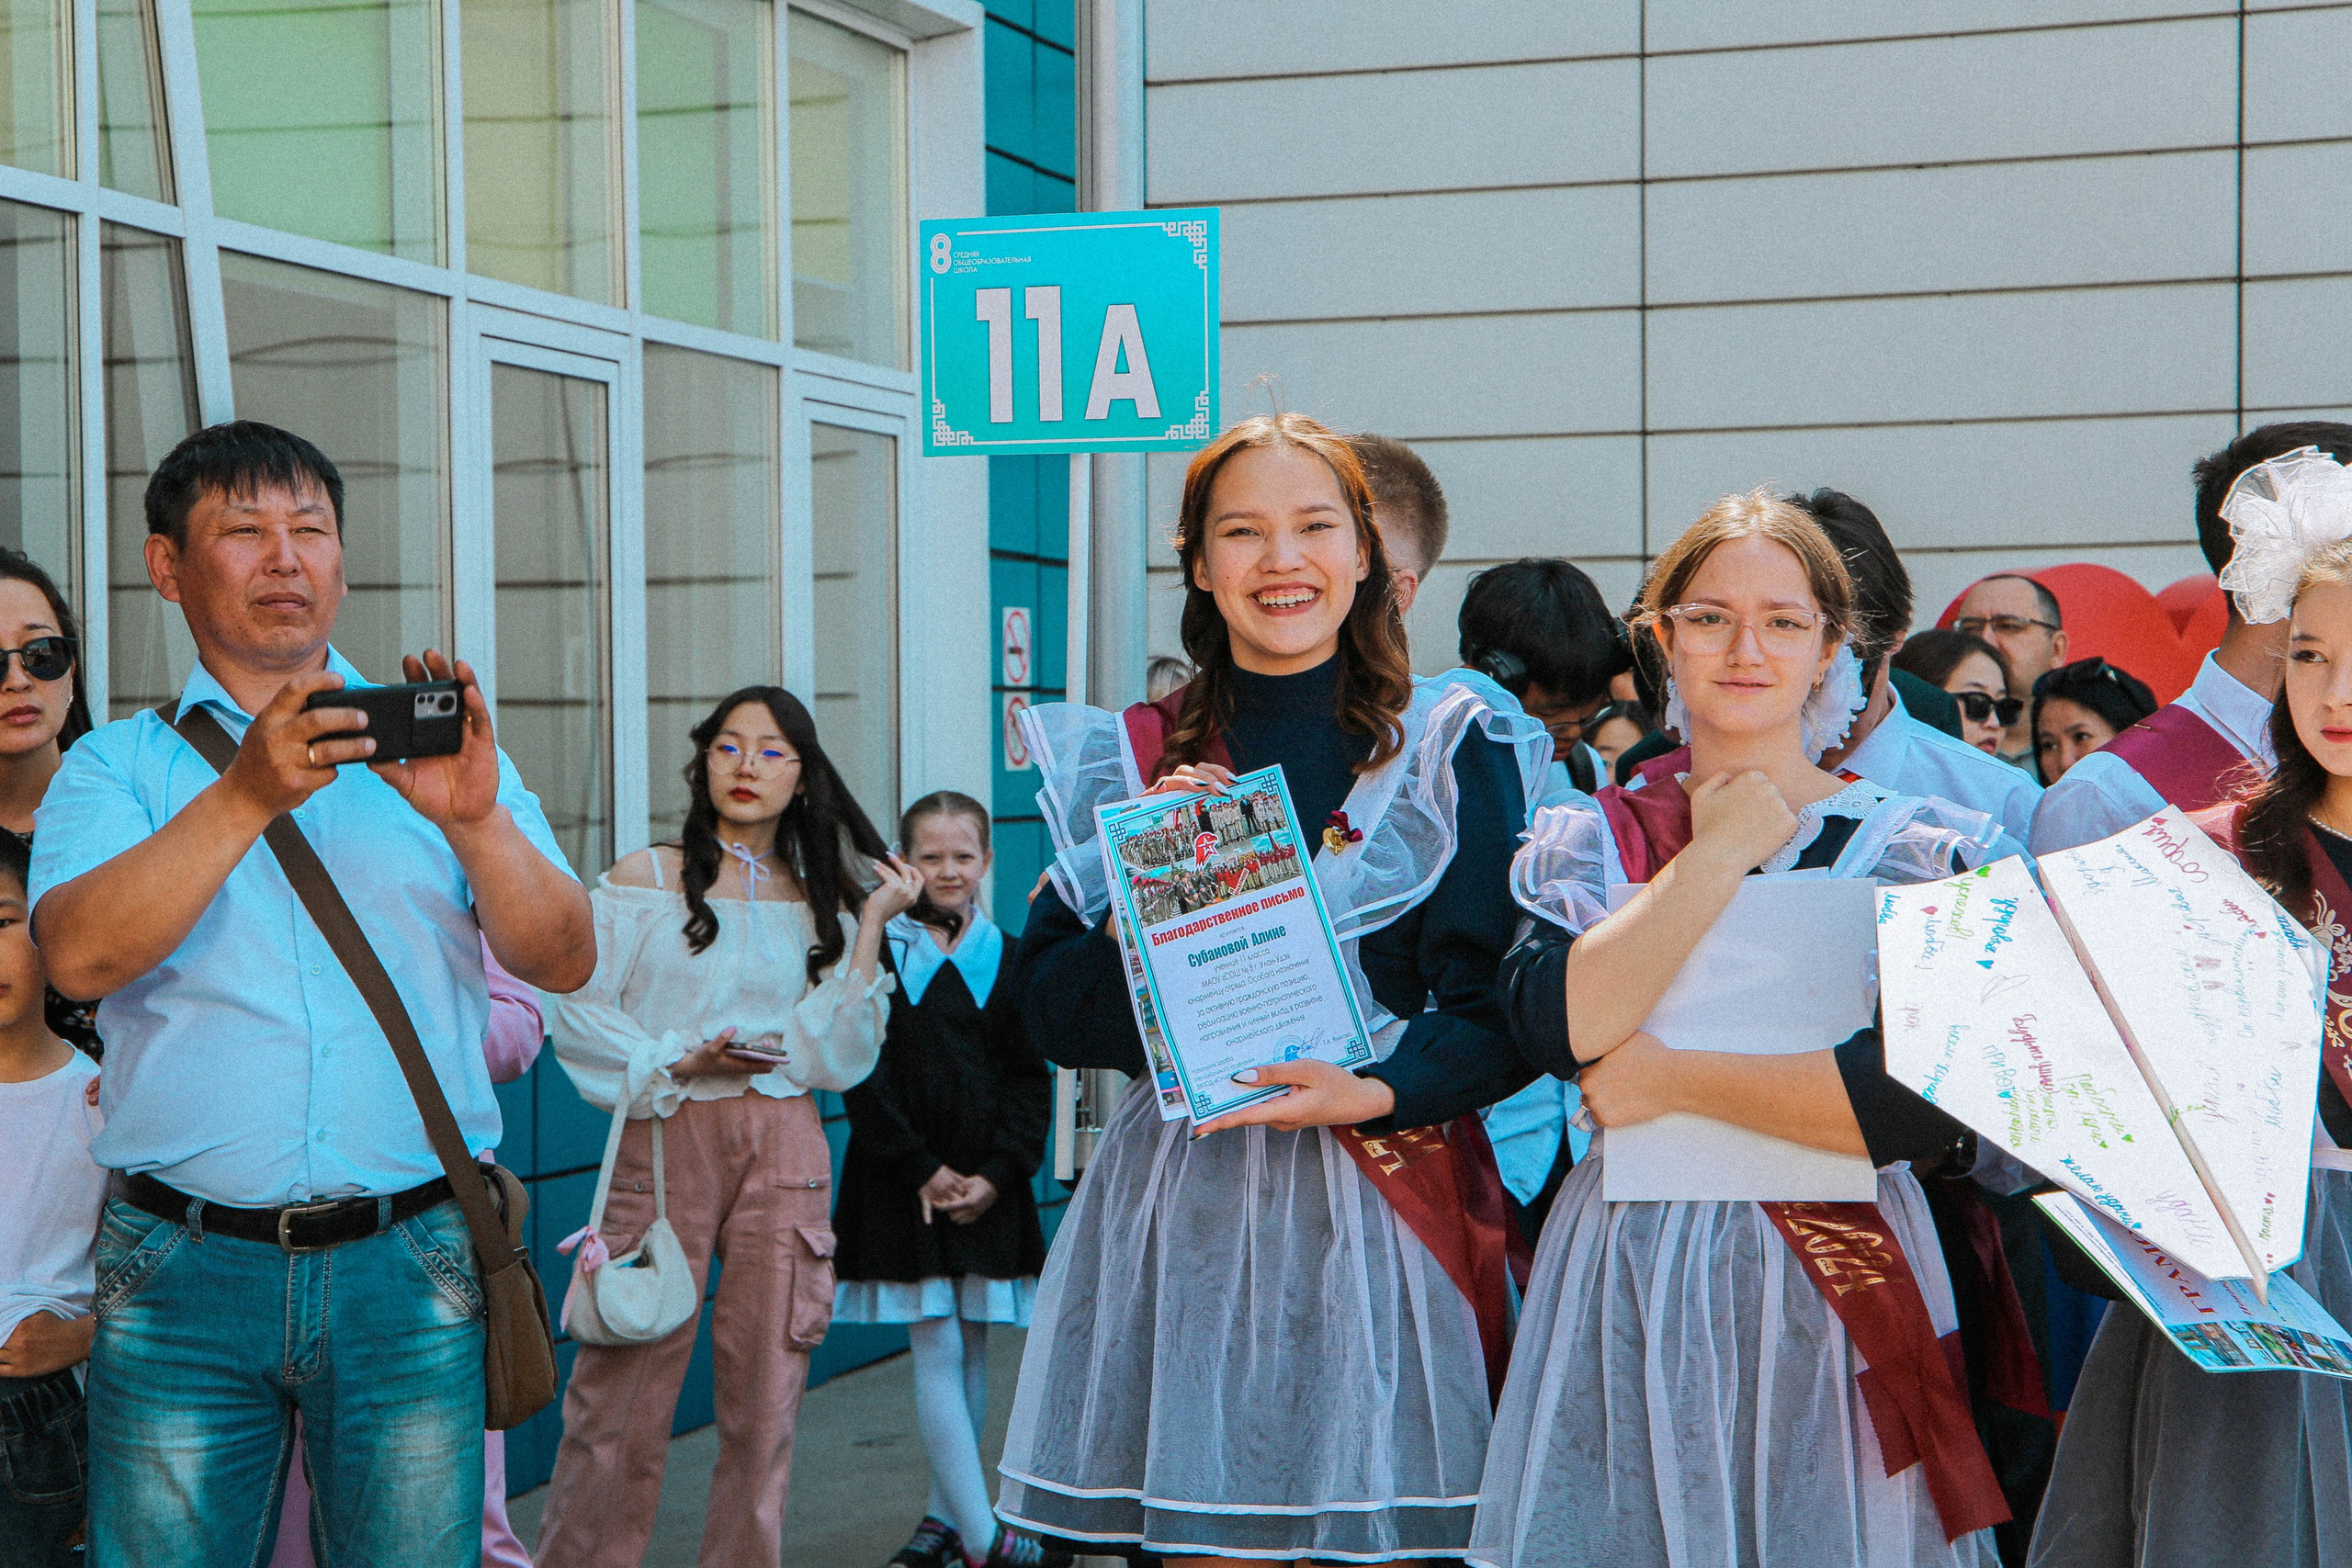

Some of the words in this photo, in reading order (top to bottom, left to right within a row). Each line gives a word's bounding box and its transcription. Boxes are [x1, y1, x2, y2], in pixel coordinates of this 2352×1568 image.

[930, 232, 952, 274] 8
[953, 251, 980, 259] СРЕДНЯЯ
[953, 256, 1032, 266] ОБЩЕОБРАЗОВАТЕЛЬНАЯ
[976, 286, 1063, 423] 11
[1084, 304, 1162, 421] А
[1151, 901, 1259, 946] Благодарственное
[1260, 886, 1305, 909] письмо
[1187, 935, 1249, 967] Субановой
[1250, 925, 1286, 946] Алине
[1213, 958, 1238, 973] ученице
[1238, 953, 1246, 963] 11
[1247, 947, 1270, 960] класса
[1186, 987, 1224, 1004] юнармейцу
[1224, 979, 1246, 992] отряда
[1247, 969, 1274, 984] Особого
[1274, 957, 1309, 975] назначения
[1195, 1009, 1204, 1017] за
[1204, 998, 1235, 1013] активную
[1235, 983, 1279, 1004] гражданскую
[1201, 975, 1220, 987] МАОУ
[1196, 1010, 1238, 1031] реализацию
[1238, 983, 1317, 1016] военно-патриотического
[1199, 1022, 1241, 1042] направления
[1248, 1010, 1270, 1024] личный
[1270, 1007, 1290, 1018] вклад
[1294, 994, 1322, 1010] развитие
[1225, 1024, 1273, 1046] юнармейского
[1275, 1013, 1305, 1030] движения
[1786, 1218, 1894, 1297] 2024
[2129, 1230, 2216, 1314] ГРАМО
